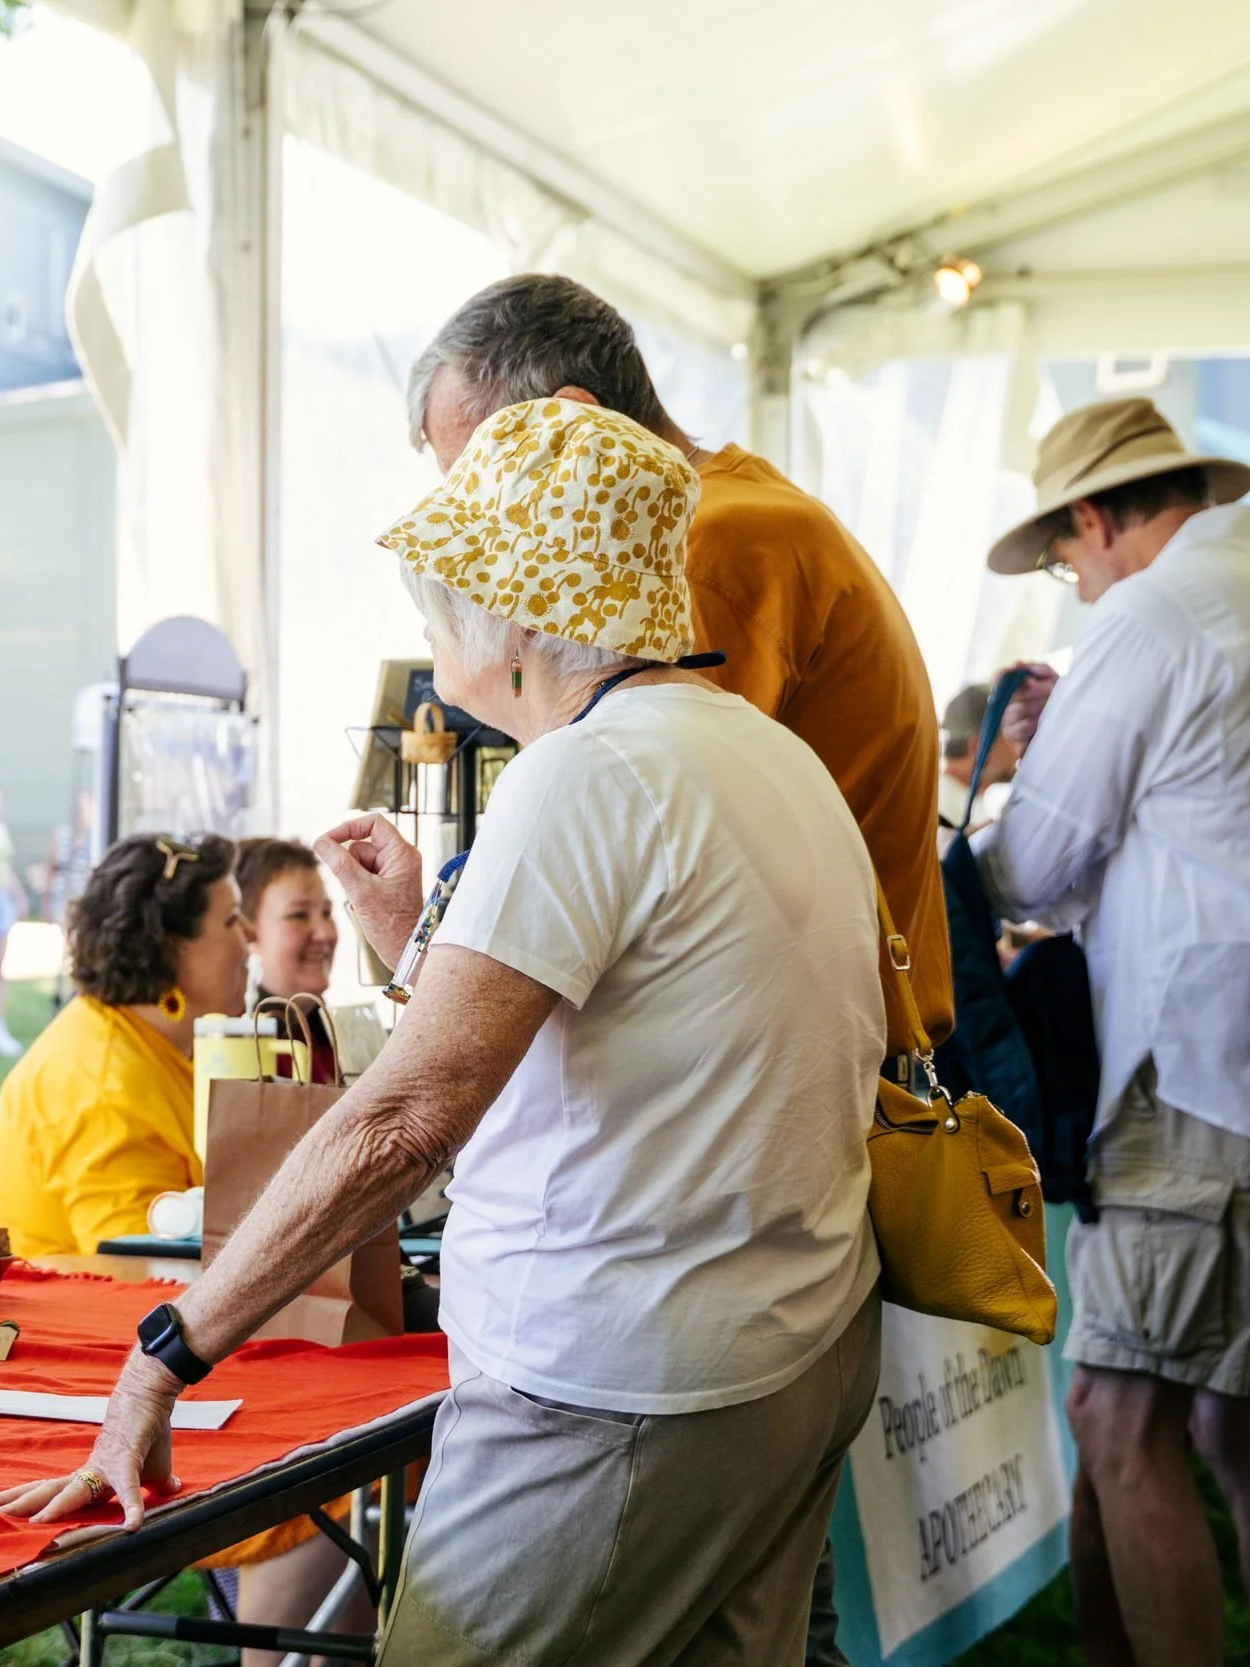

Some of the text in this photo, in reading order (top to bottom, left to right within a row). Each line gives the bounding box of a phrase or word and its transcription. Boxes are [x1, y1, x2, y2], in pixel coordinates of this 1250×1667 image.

[878, 1346, 1025, 1463] People of the Dawn
[917, 1453, 1027, 1582] APOTHECARY
